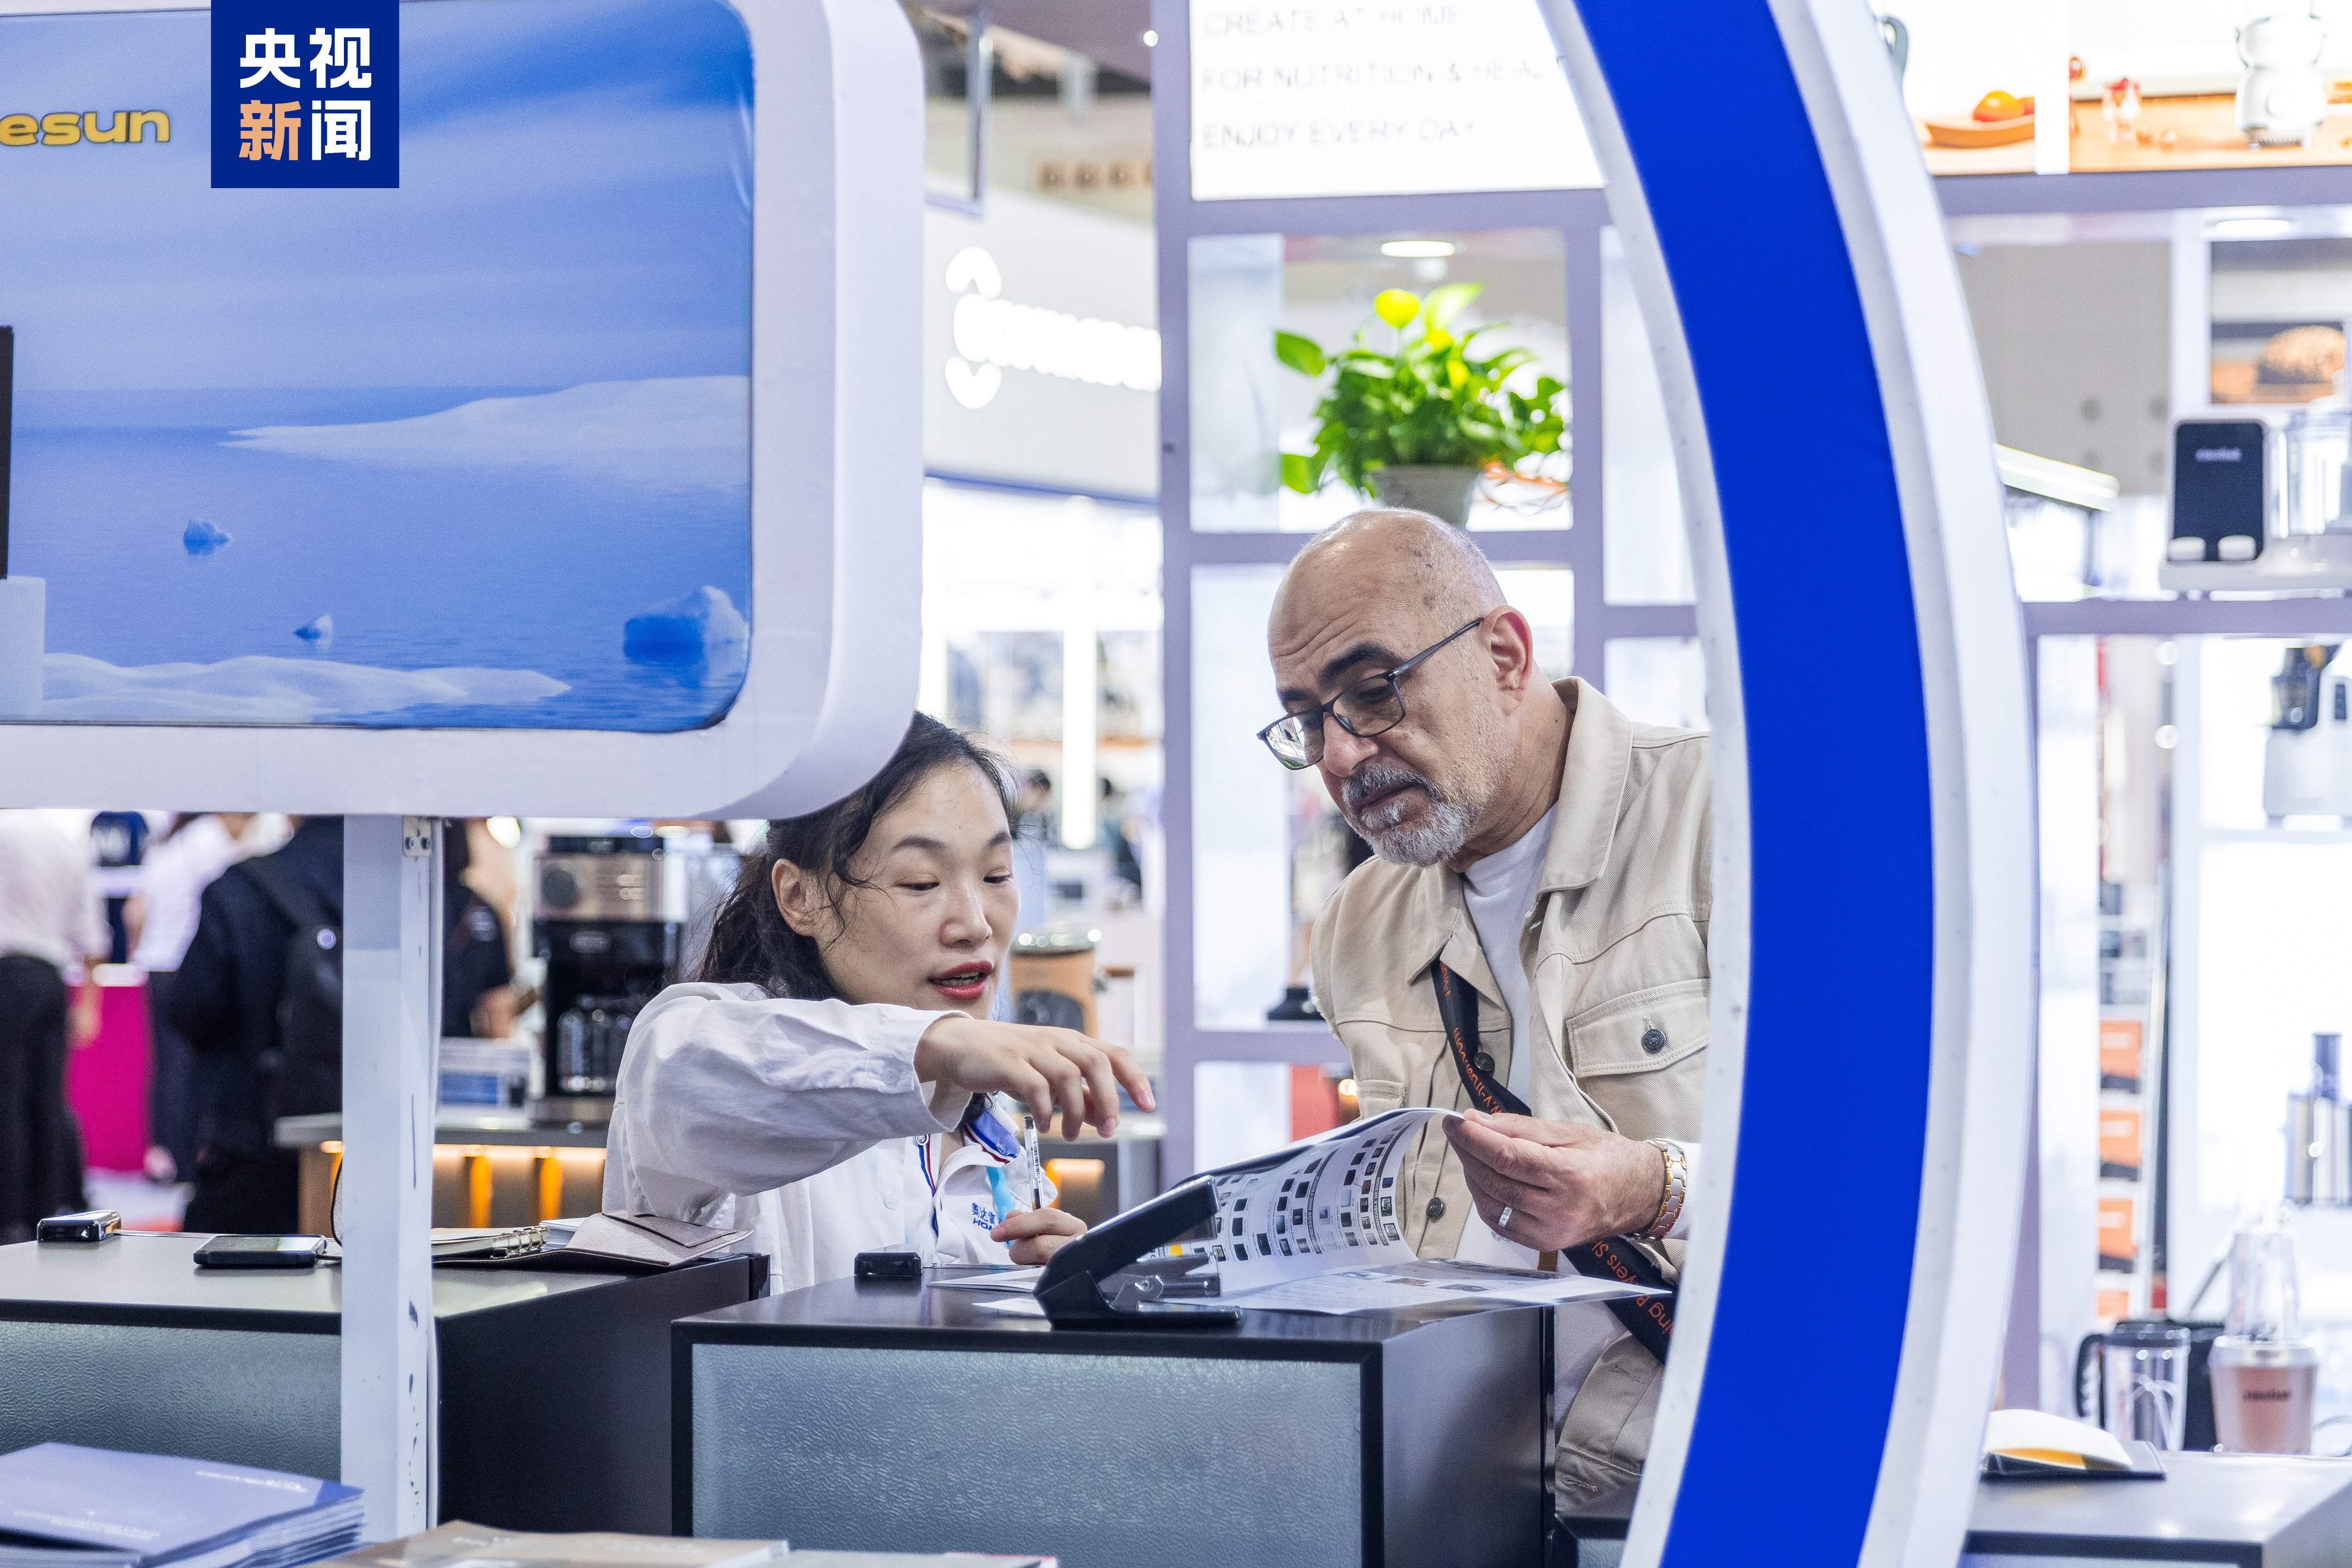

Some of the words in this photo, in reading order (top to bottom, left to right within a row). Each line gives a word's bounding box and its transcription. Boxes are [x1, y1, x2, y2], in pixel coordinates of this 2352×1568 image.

[1203, 7, 1316, 37] CREATE
[1202, 67, 1263, 92] FOR
[1274, 61, 1433, 89] NUTRITION
[1202, 122, 1299, 150] ENJOY
[1309, 117, 1408, 146] EVERY
[1419, 116, 1478, 142] DAY
[1308, 1212, 1320, 1252] COMPRESSOR
